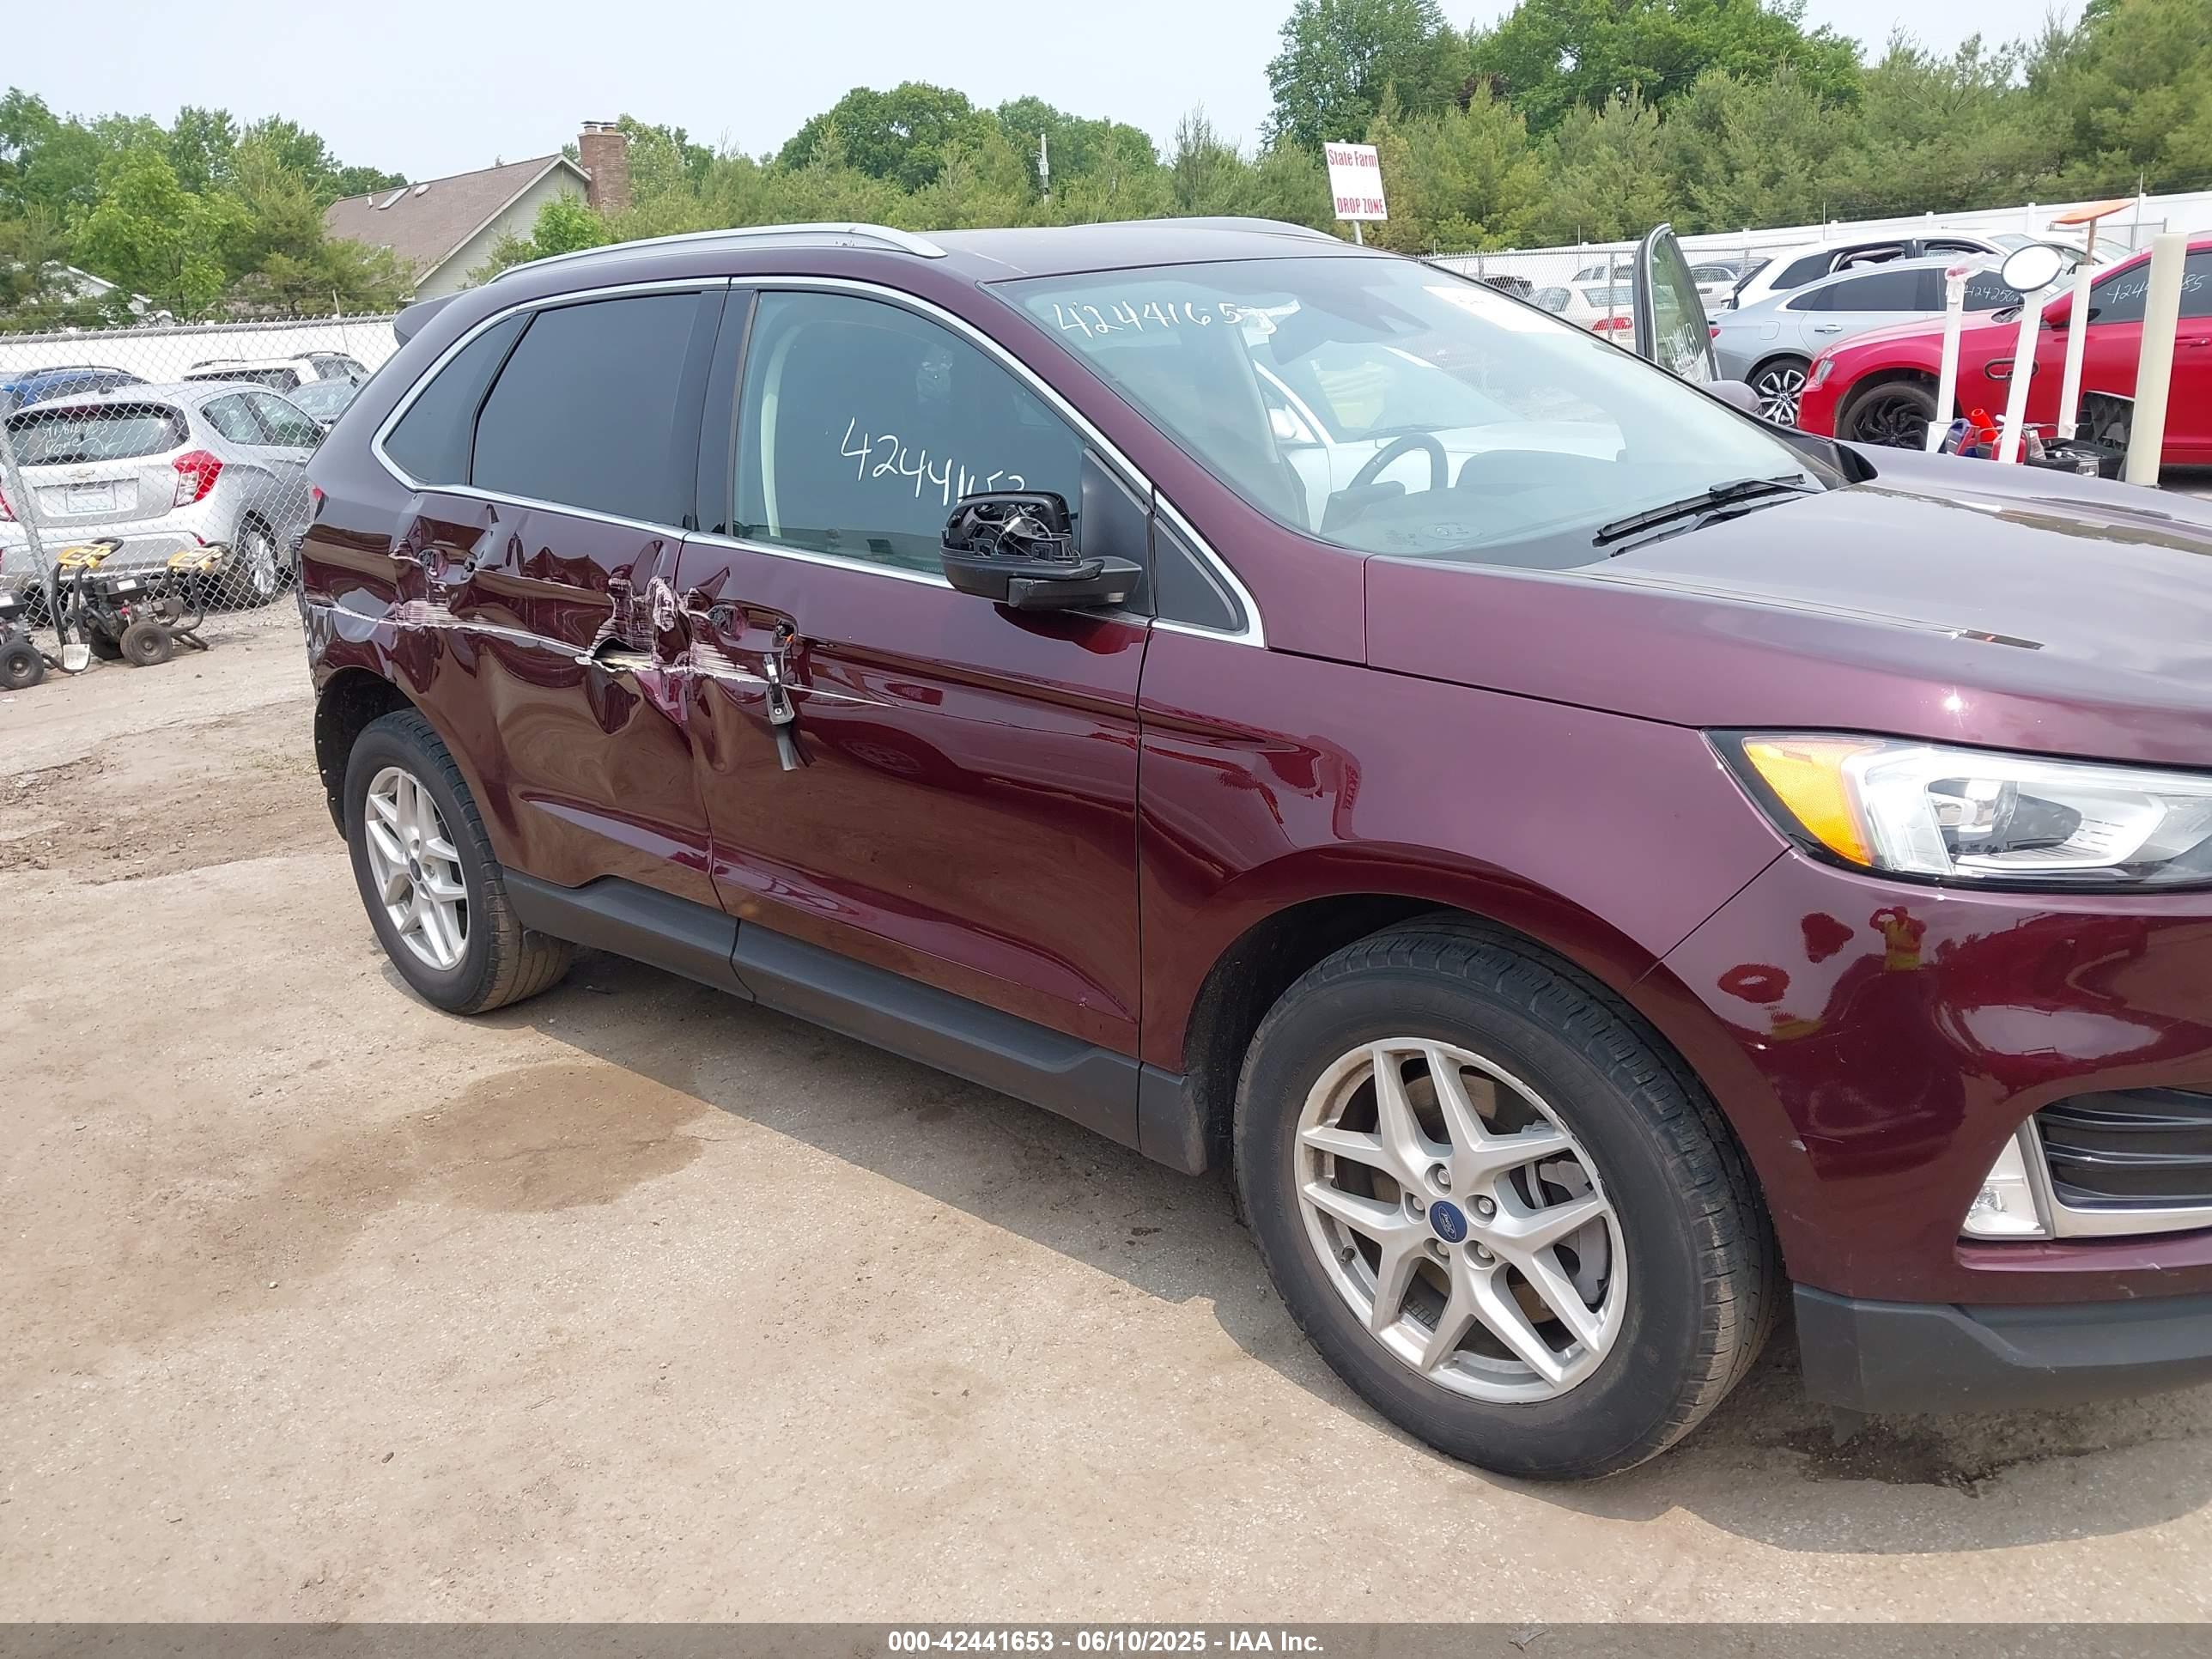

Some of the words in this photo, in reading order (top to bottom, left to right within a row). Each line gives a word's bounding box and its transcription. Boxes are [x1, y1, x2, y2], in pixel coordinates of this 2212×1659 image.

[1328, 149, 1353, 166] State
[1354, 151, 1377, 167] Farm
[1336, 198, 1361, 214] DROP
[1362, 198, 1385, 214] ZONE
